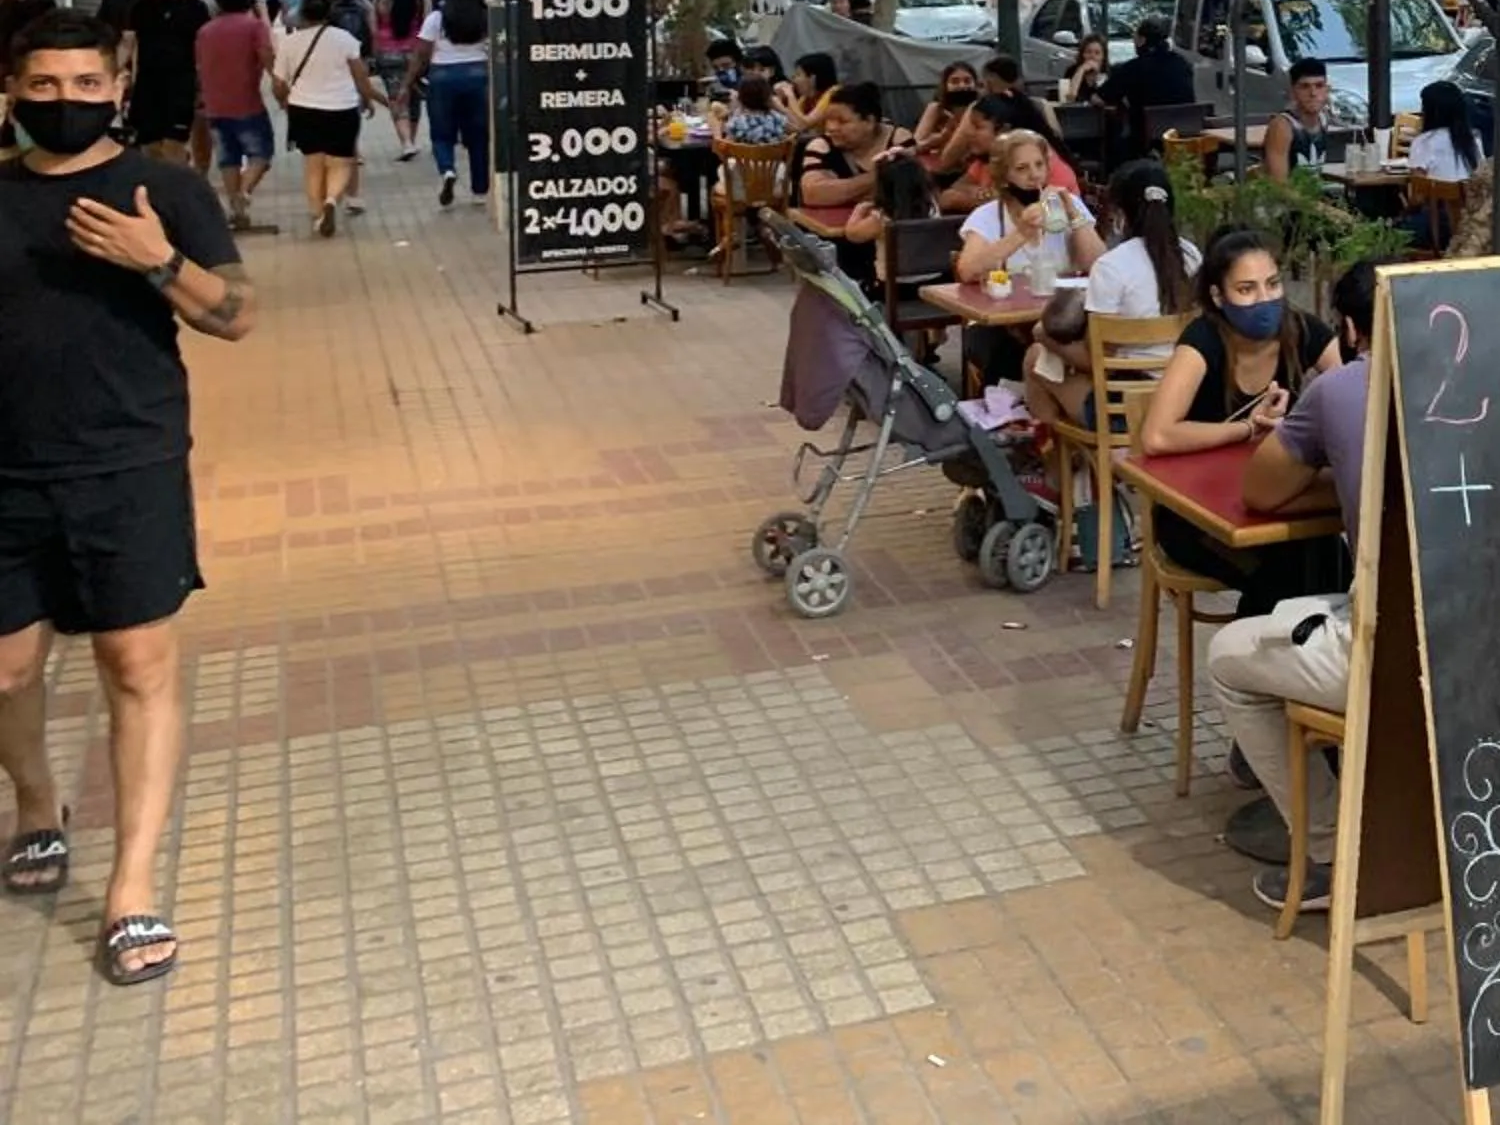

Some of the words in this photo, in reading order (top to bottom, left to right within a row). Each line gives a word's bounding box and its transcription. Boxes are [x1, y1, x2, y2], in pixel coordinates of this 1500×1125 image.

[529, 42, 633, 62] BERMUDA
[539, 88, 626, 109] REMERA
[527, 126, 638, 162] 3.000
[528, 175, 638, 200] CALZADOS
[1424, 303, 1490, 425] 2
[1430, 452, 1494, 528] +
